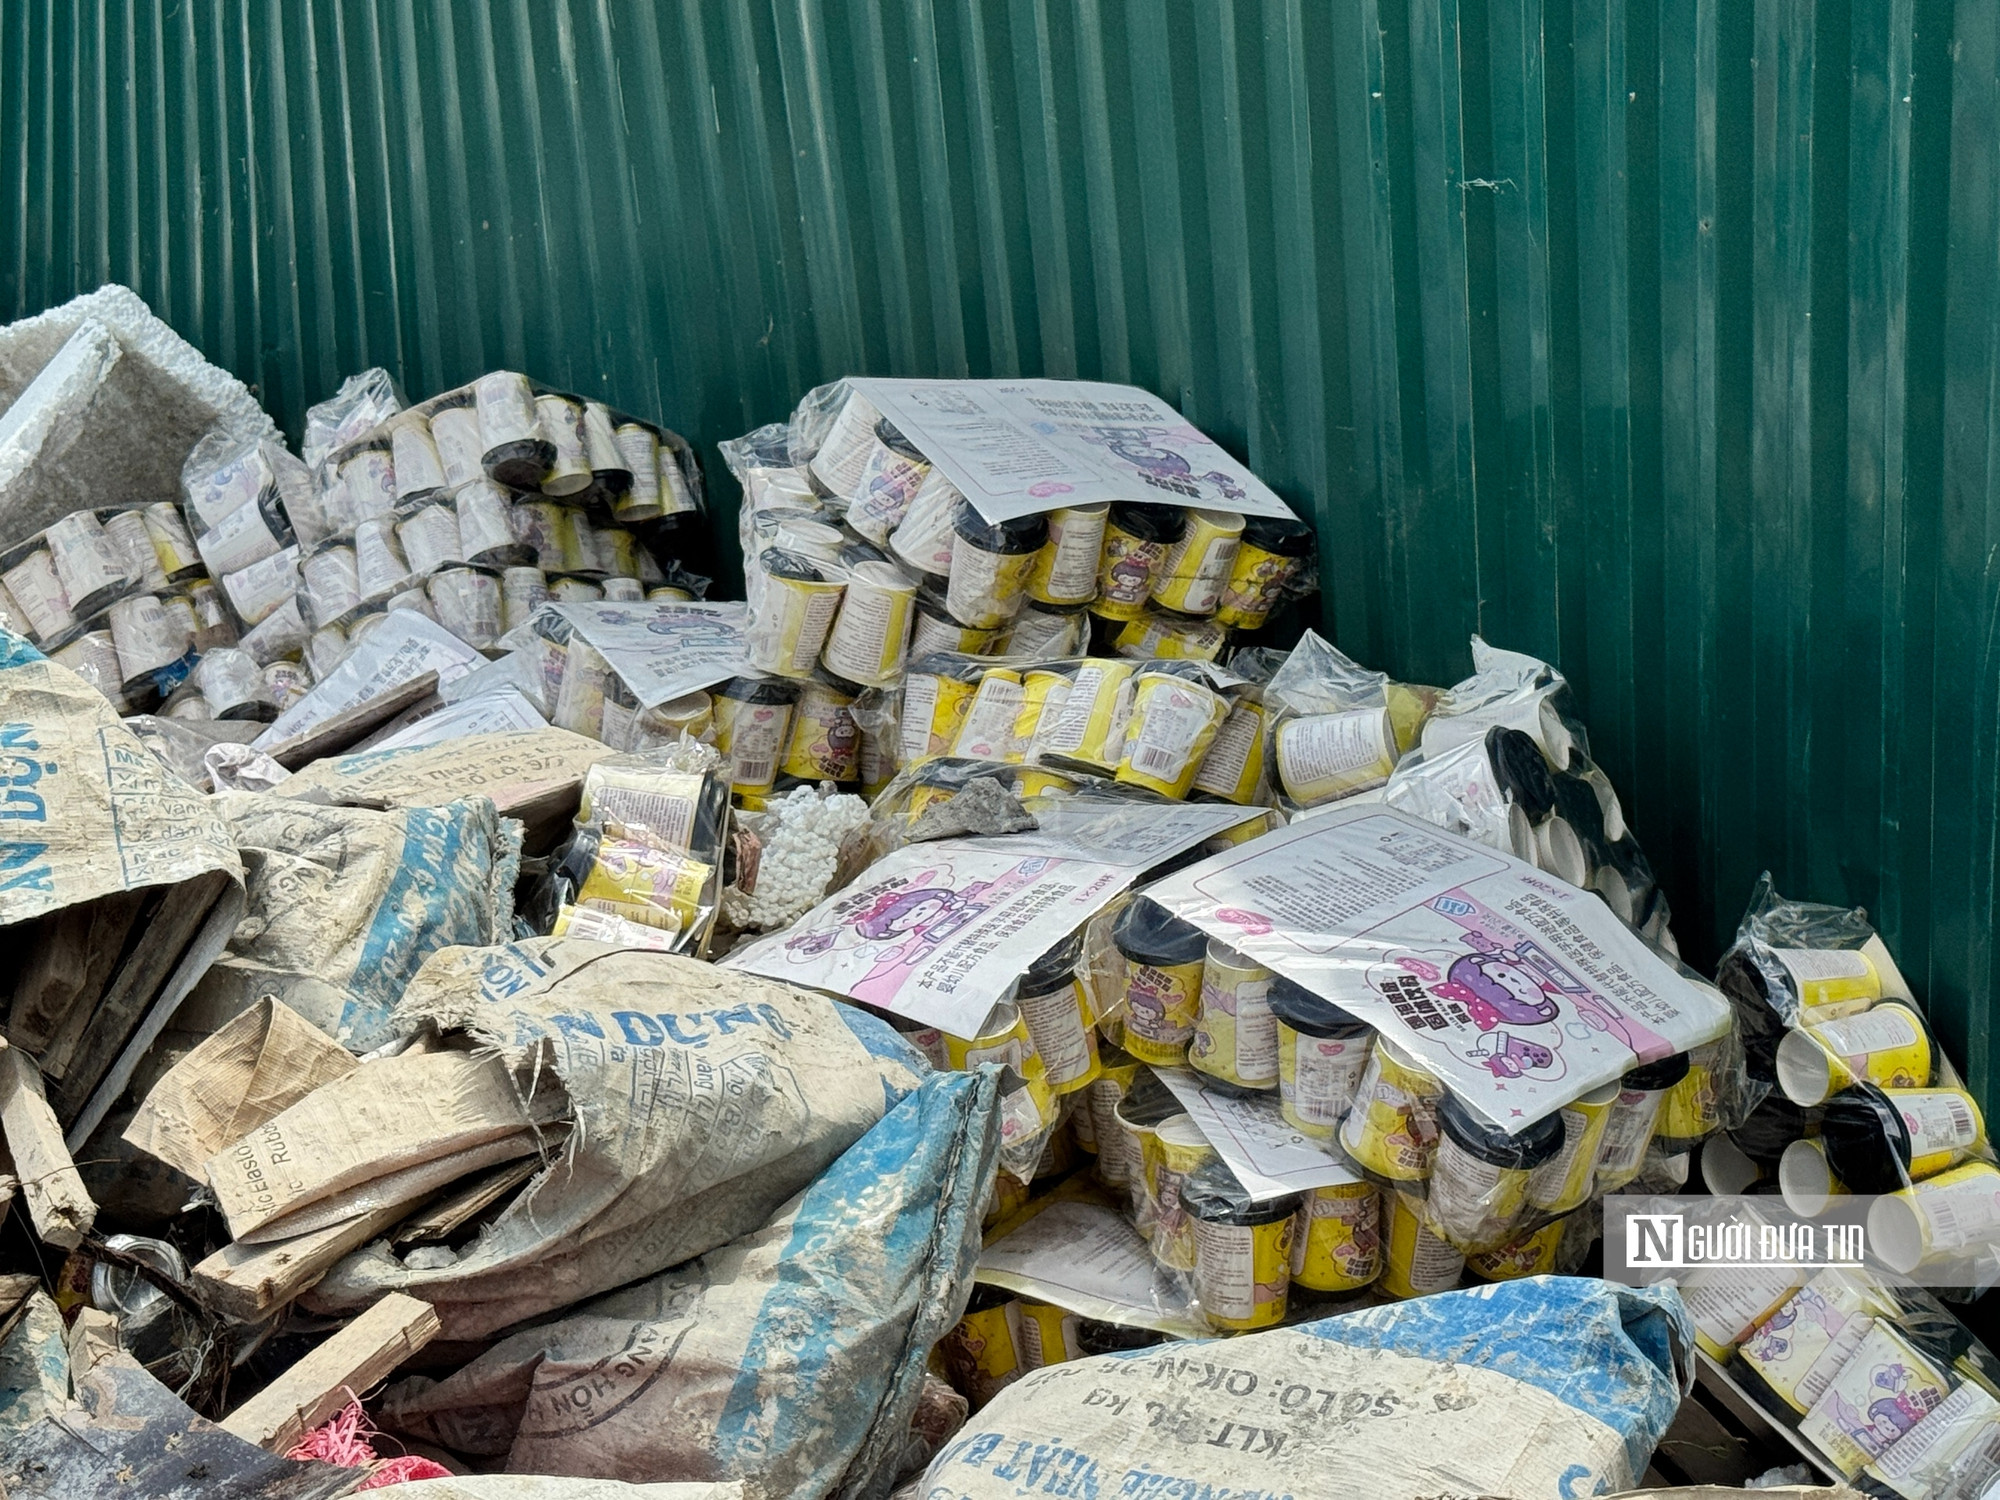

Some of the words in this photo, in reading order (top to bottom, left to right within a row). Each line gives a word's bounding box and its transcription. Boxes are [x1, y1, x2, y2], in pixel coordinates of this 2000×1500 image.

[236, 1143, 270, 1193] Elasto
[615, 1327, 670, 1378] ĂNG
[1083, 1387, 1132, 1417] kg
